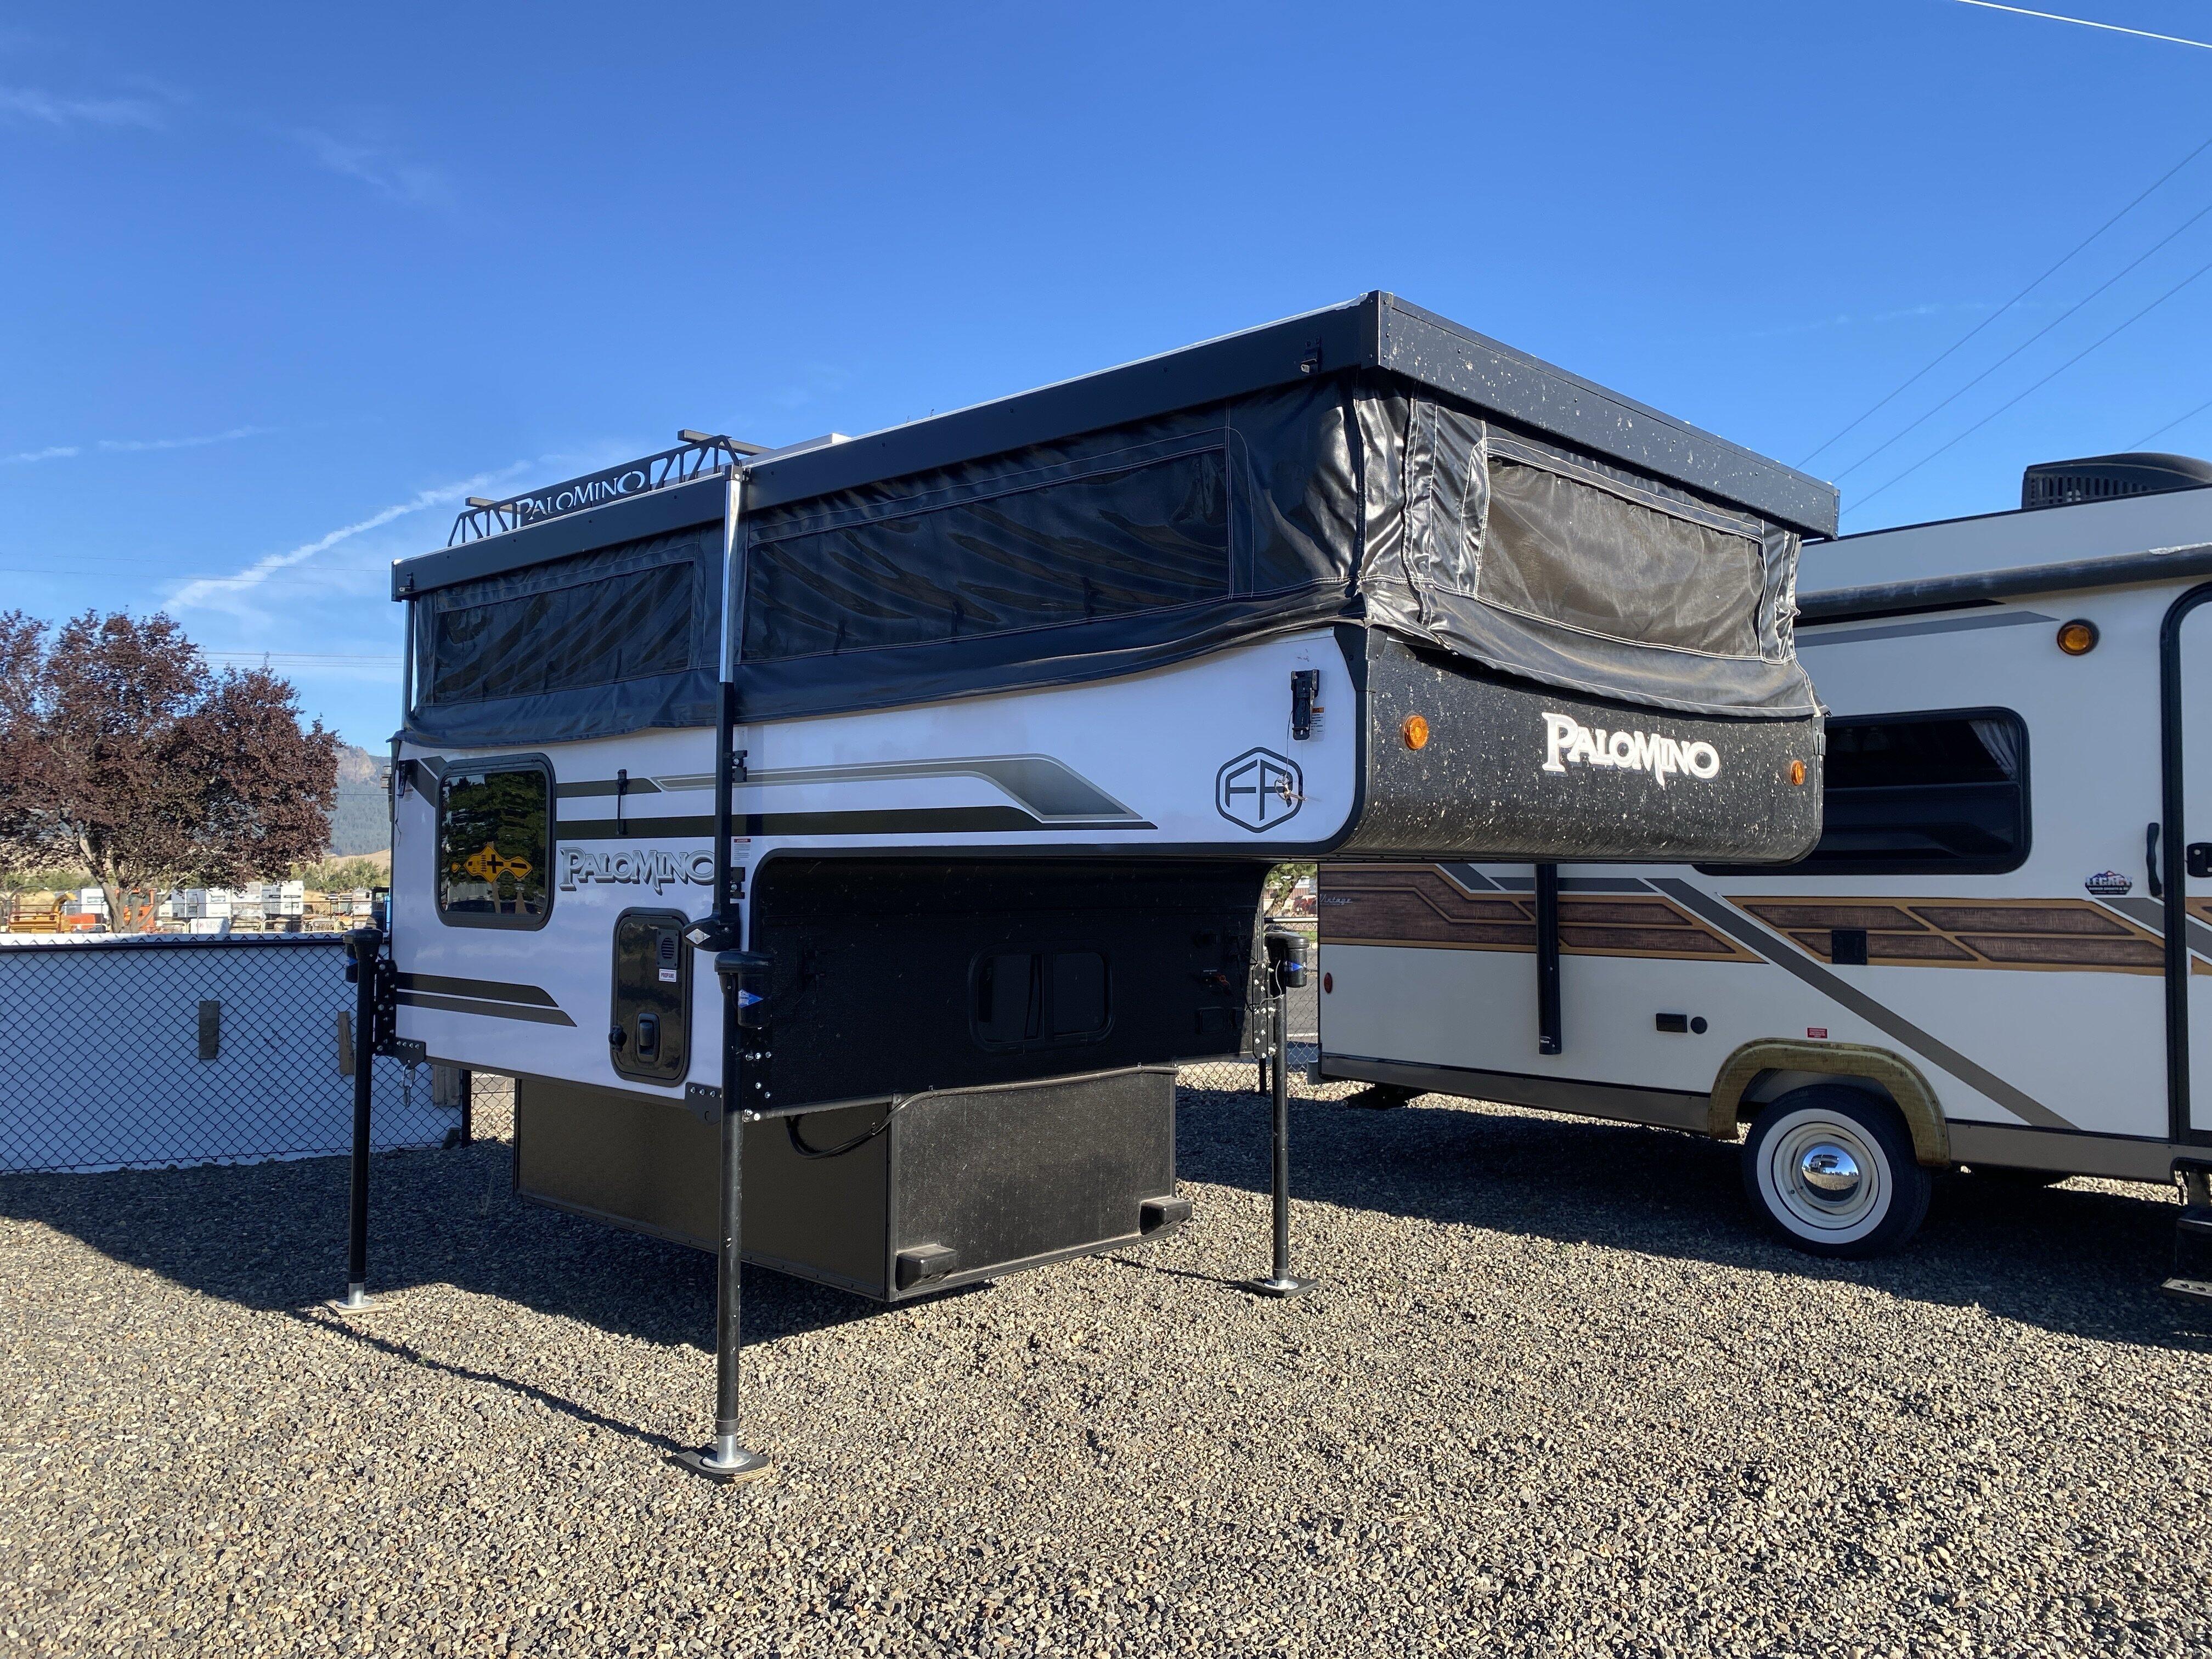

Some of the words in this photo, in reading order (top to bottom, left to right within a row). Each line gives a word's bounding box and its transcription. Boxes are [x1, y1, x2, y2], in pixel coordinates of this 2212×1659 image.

[515, 471, 646, 528] PALOMINO
[1542, 712, 1720, 790] PALOMINO
[559, 847, 715, 895] PALOMINO
[1319, 893, 1353, 905] Vintage
